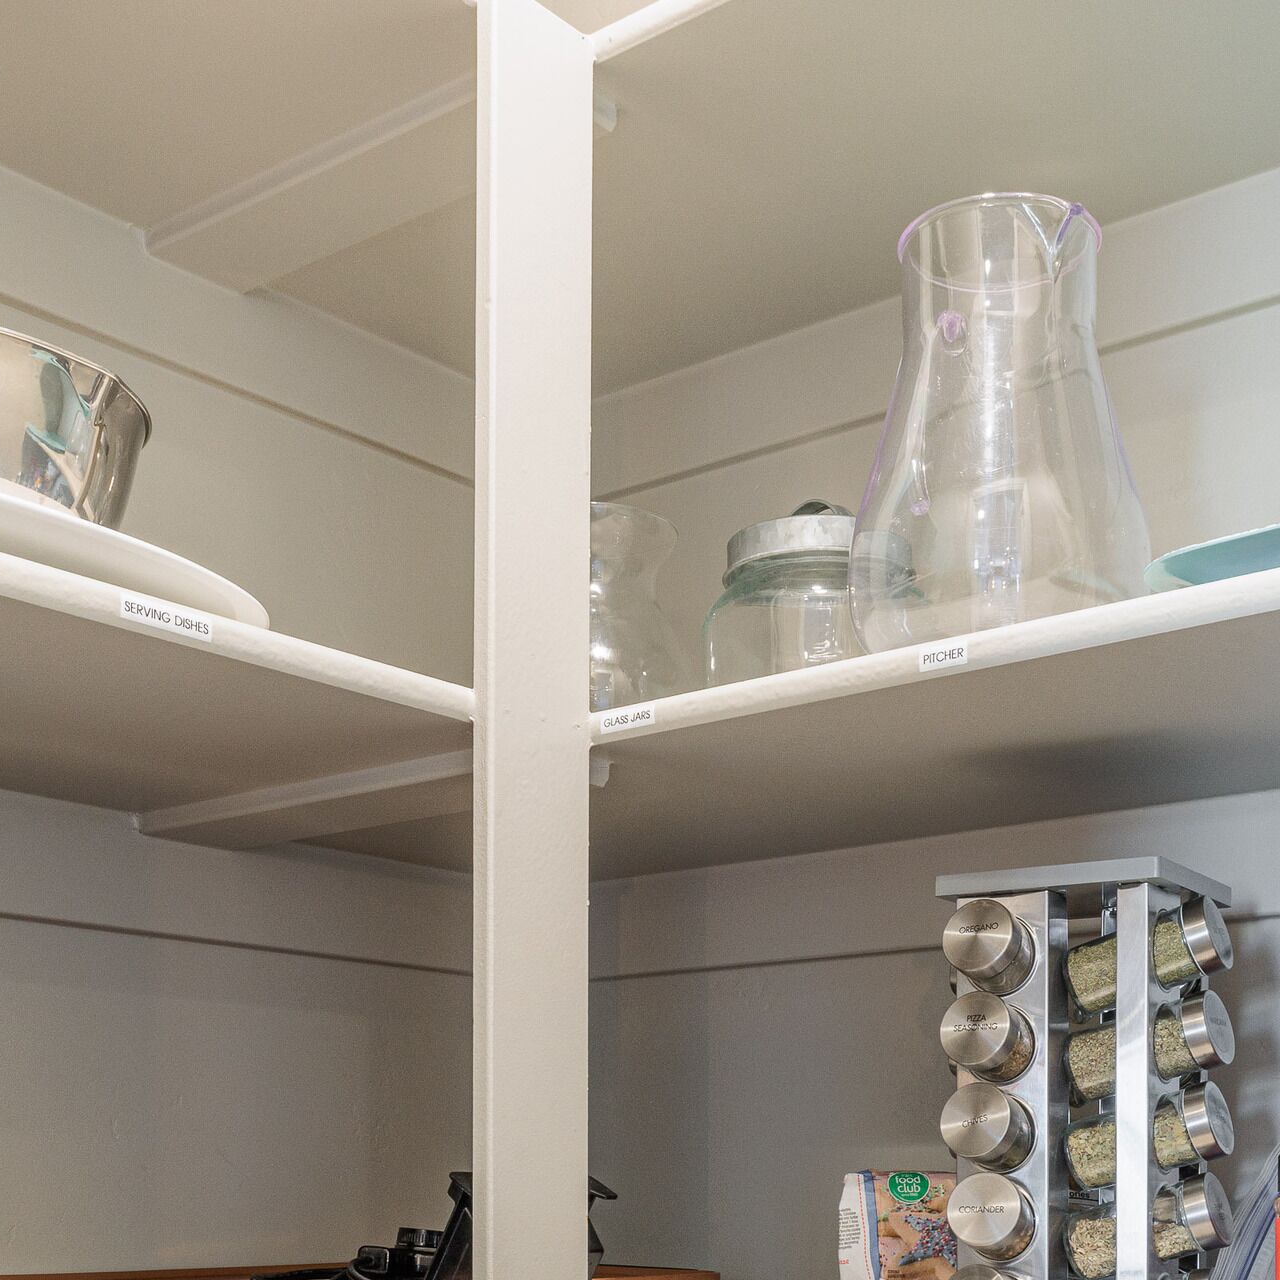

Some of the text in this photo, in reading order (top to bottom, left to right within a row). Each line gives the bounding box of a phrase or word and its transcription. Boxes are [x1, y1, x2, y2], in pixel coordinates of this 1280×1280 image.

[124, 600, 209, 635] SERVING DISHES
[923, 647, 964, 664] PITCHER
[603, 710, 650, 728] GLASS JARS
[958, 921, 999, 935] OREGANO
[966, 1013, 987, 1023] PIZZA
[952, 1022, 998, 1032] SEASONING
[961, 1114, 988, 1128] CHIVES
[895, 1176, 920, 1184] food
[897, 1183, 921, 1193] club
[958, 1204, 1005, 1214] CORIANDER
